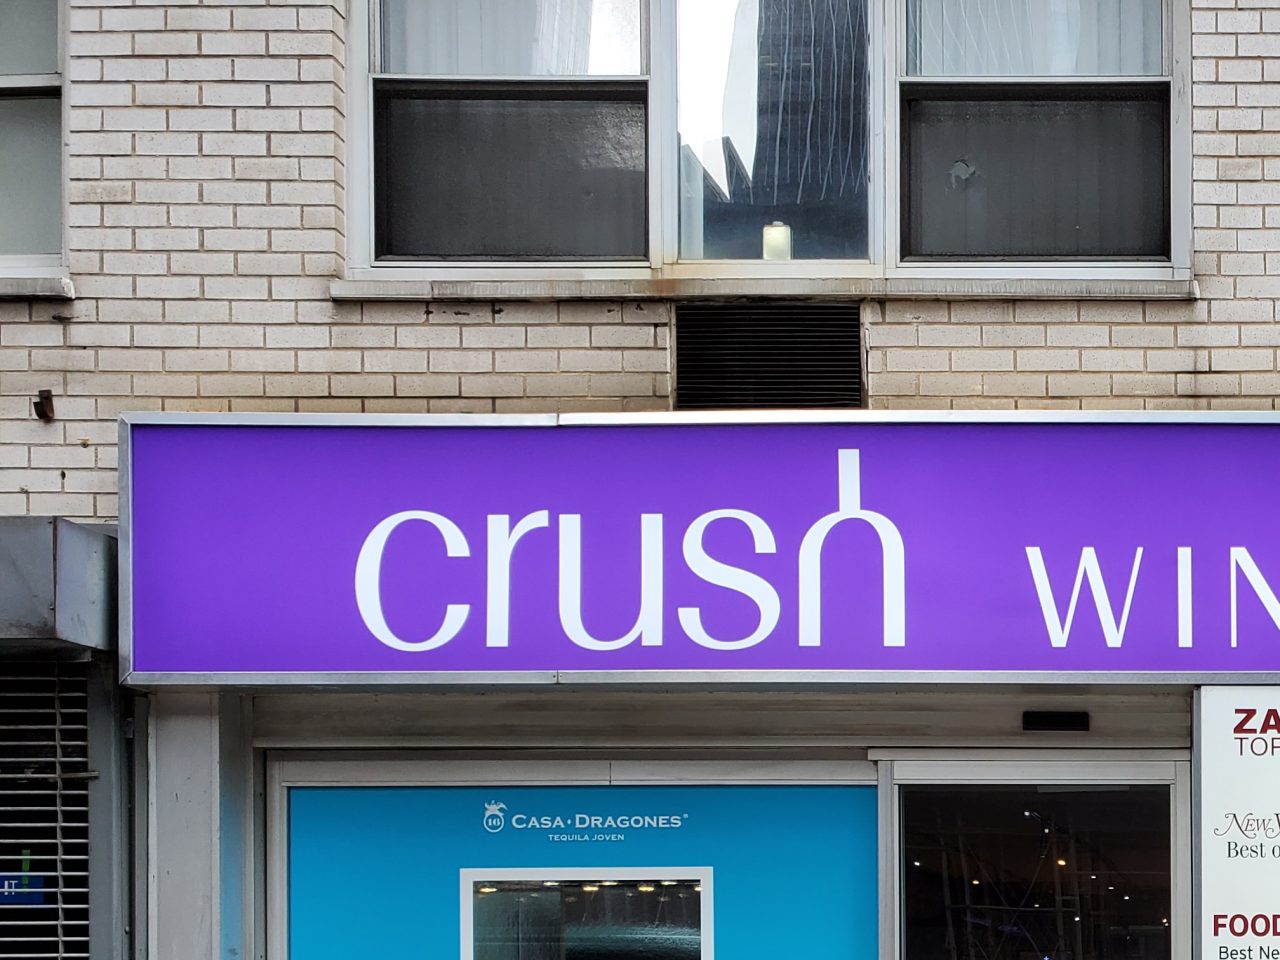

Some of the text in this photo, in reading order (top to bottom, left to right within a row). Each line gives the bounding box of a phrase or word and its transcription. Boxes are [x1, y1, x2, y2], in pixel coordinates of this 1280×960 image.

[354, 448, 906, 652] crush
[511, 813, 682, 829] CASA DRAGONES
[1227, 841, 1266, 858] Best
[1219, 946, 1253, 960] Best
